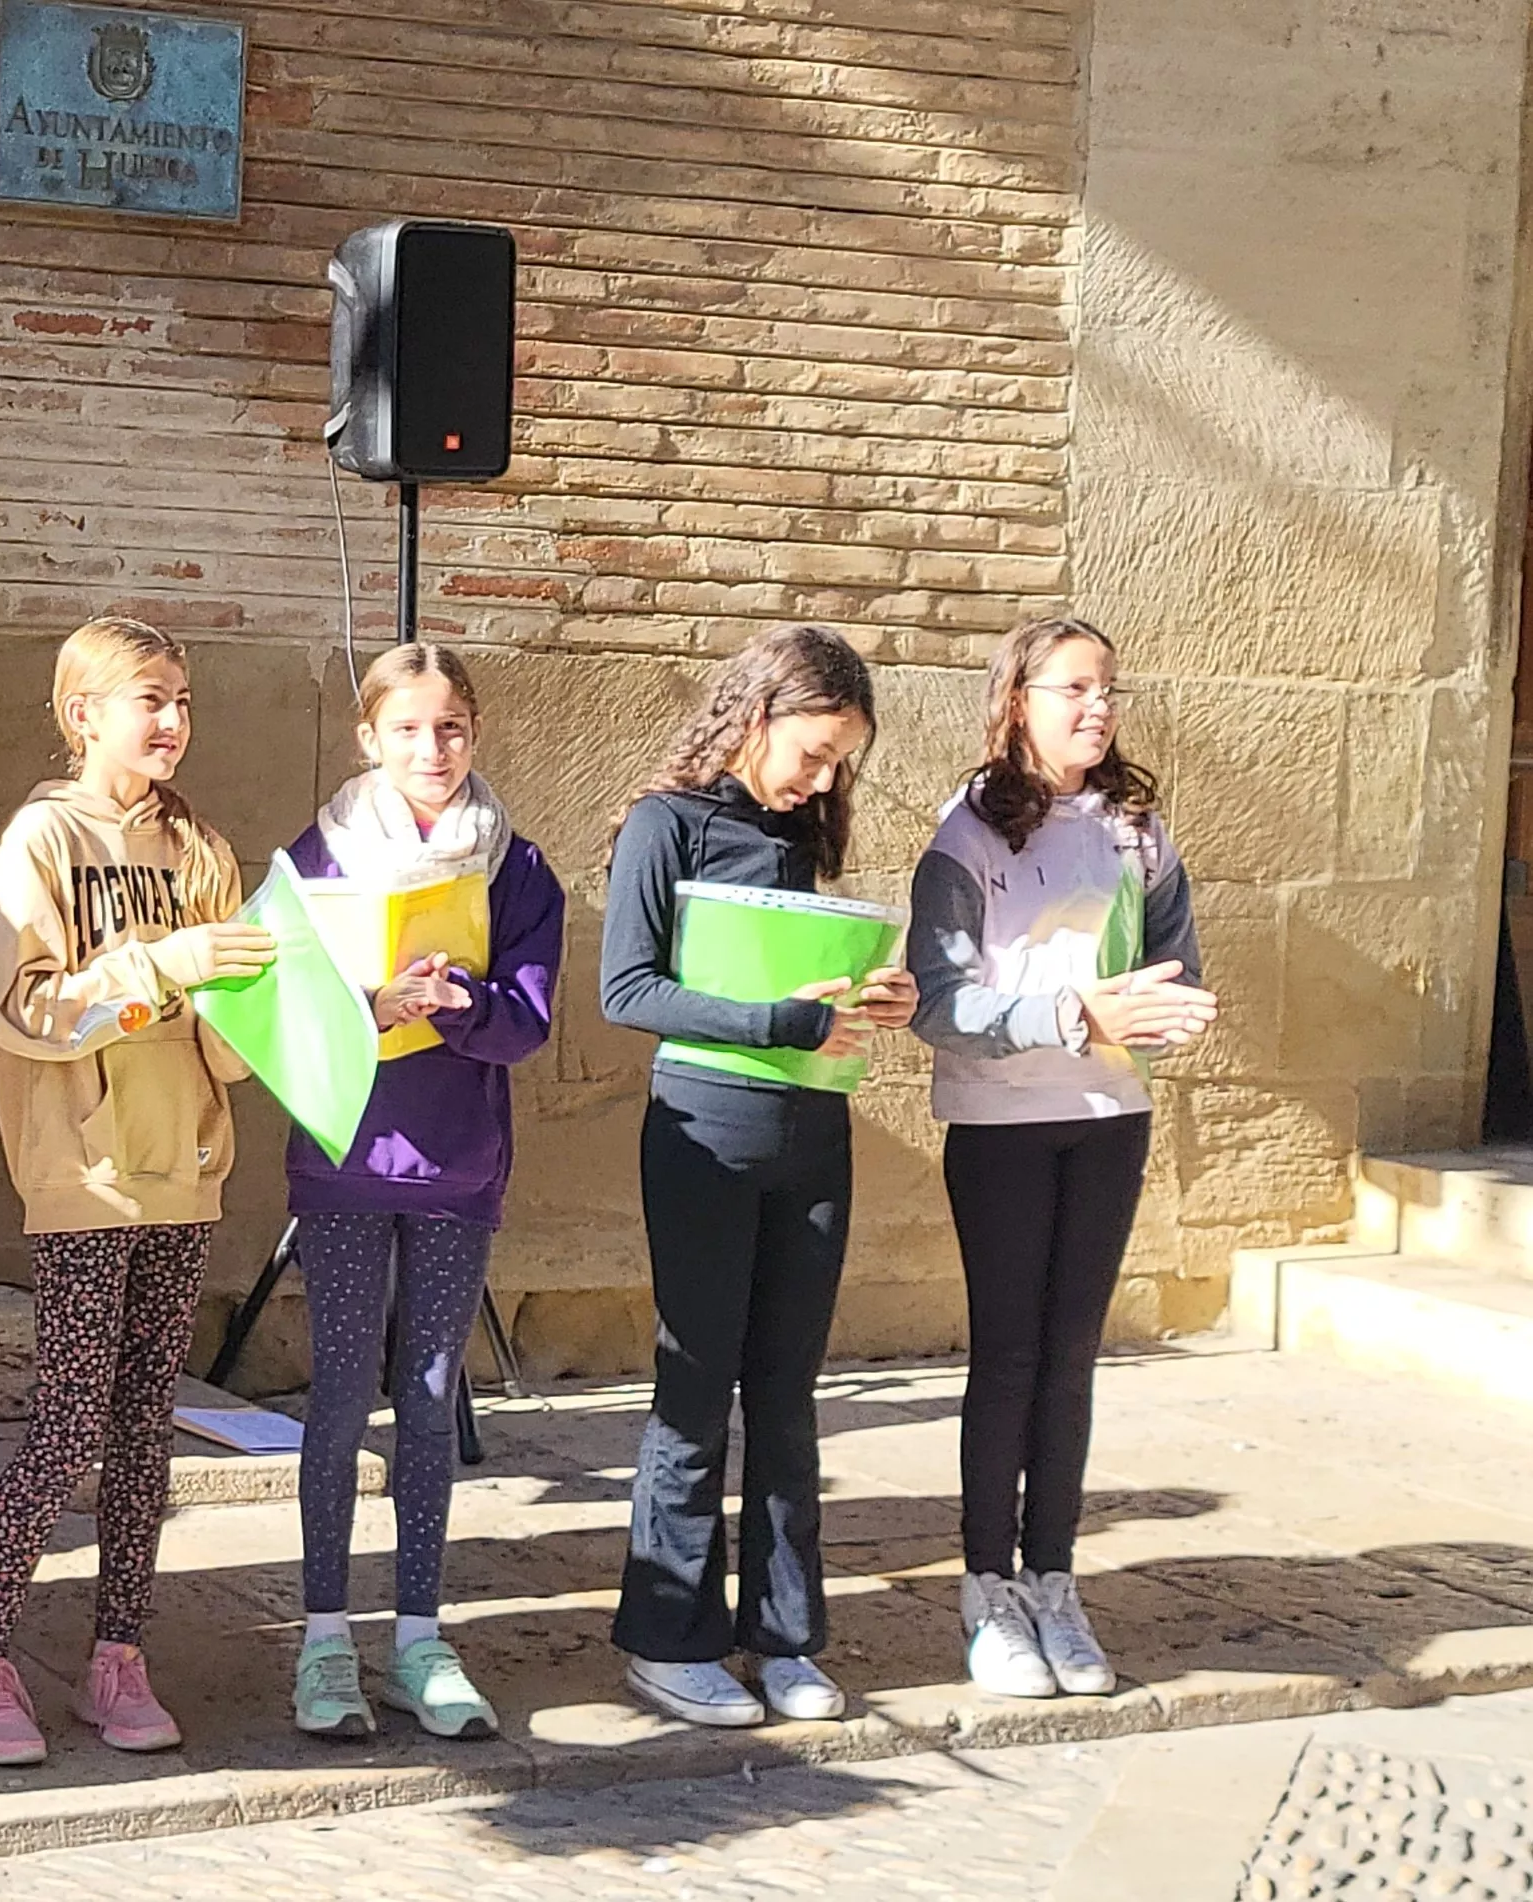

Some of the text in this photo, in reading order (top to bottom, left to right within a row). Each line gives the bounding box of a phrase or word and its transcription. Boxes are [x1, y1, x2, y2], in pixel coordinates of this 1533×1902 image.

[4, 95, 234, 154] AYUNTAMIENTO
[35, 146, 65, 171] DE
[70, 865, 186, 965] OGWAR
